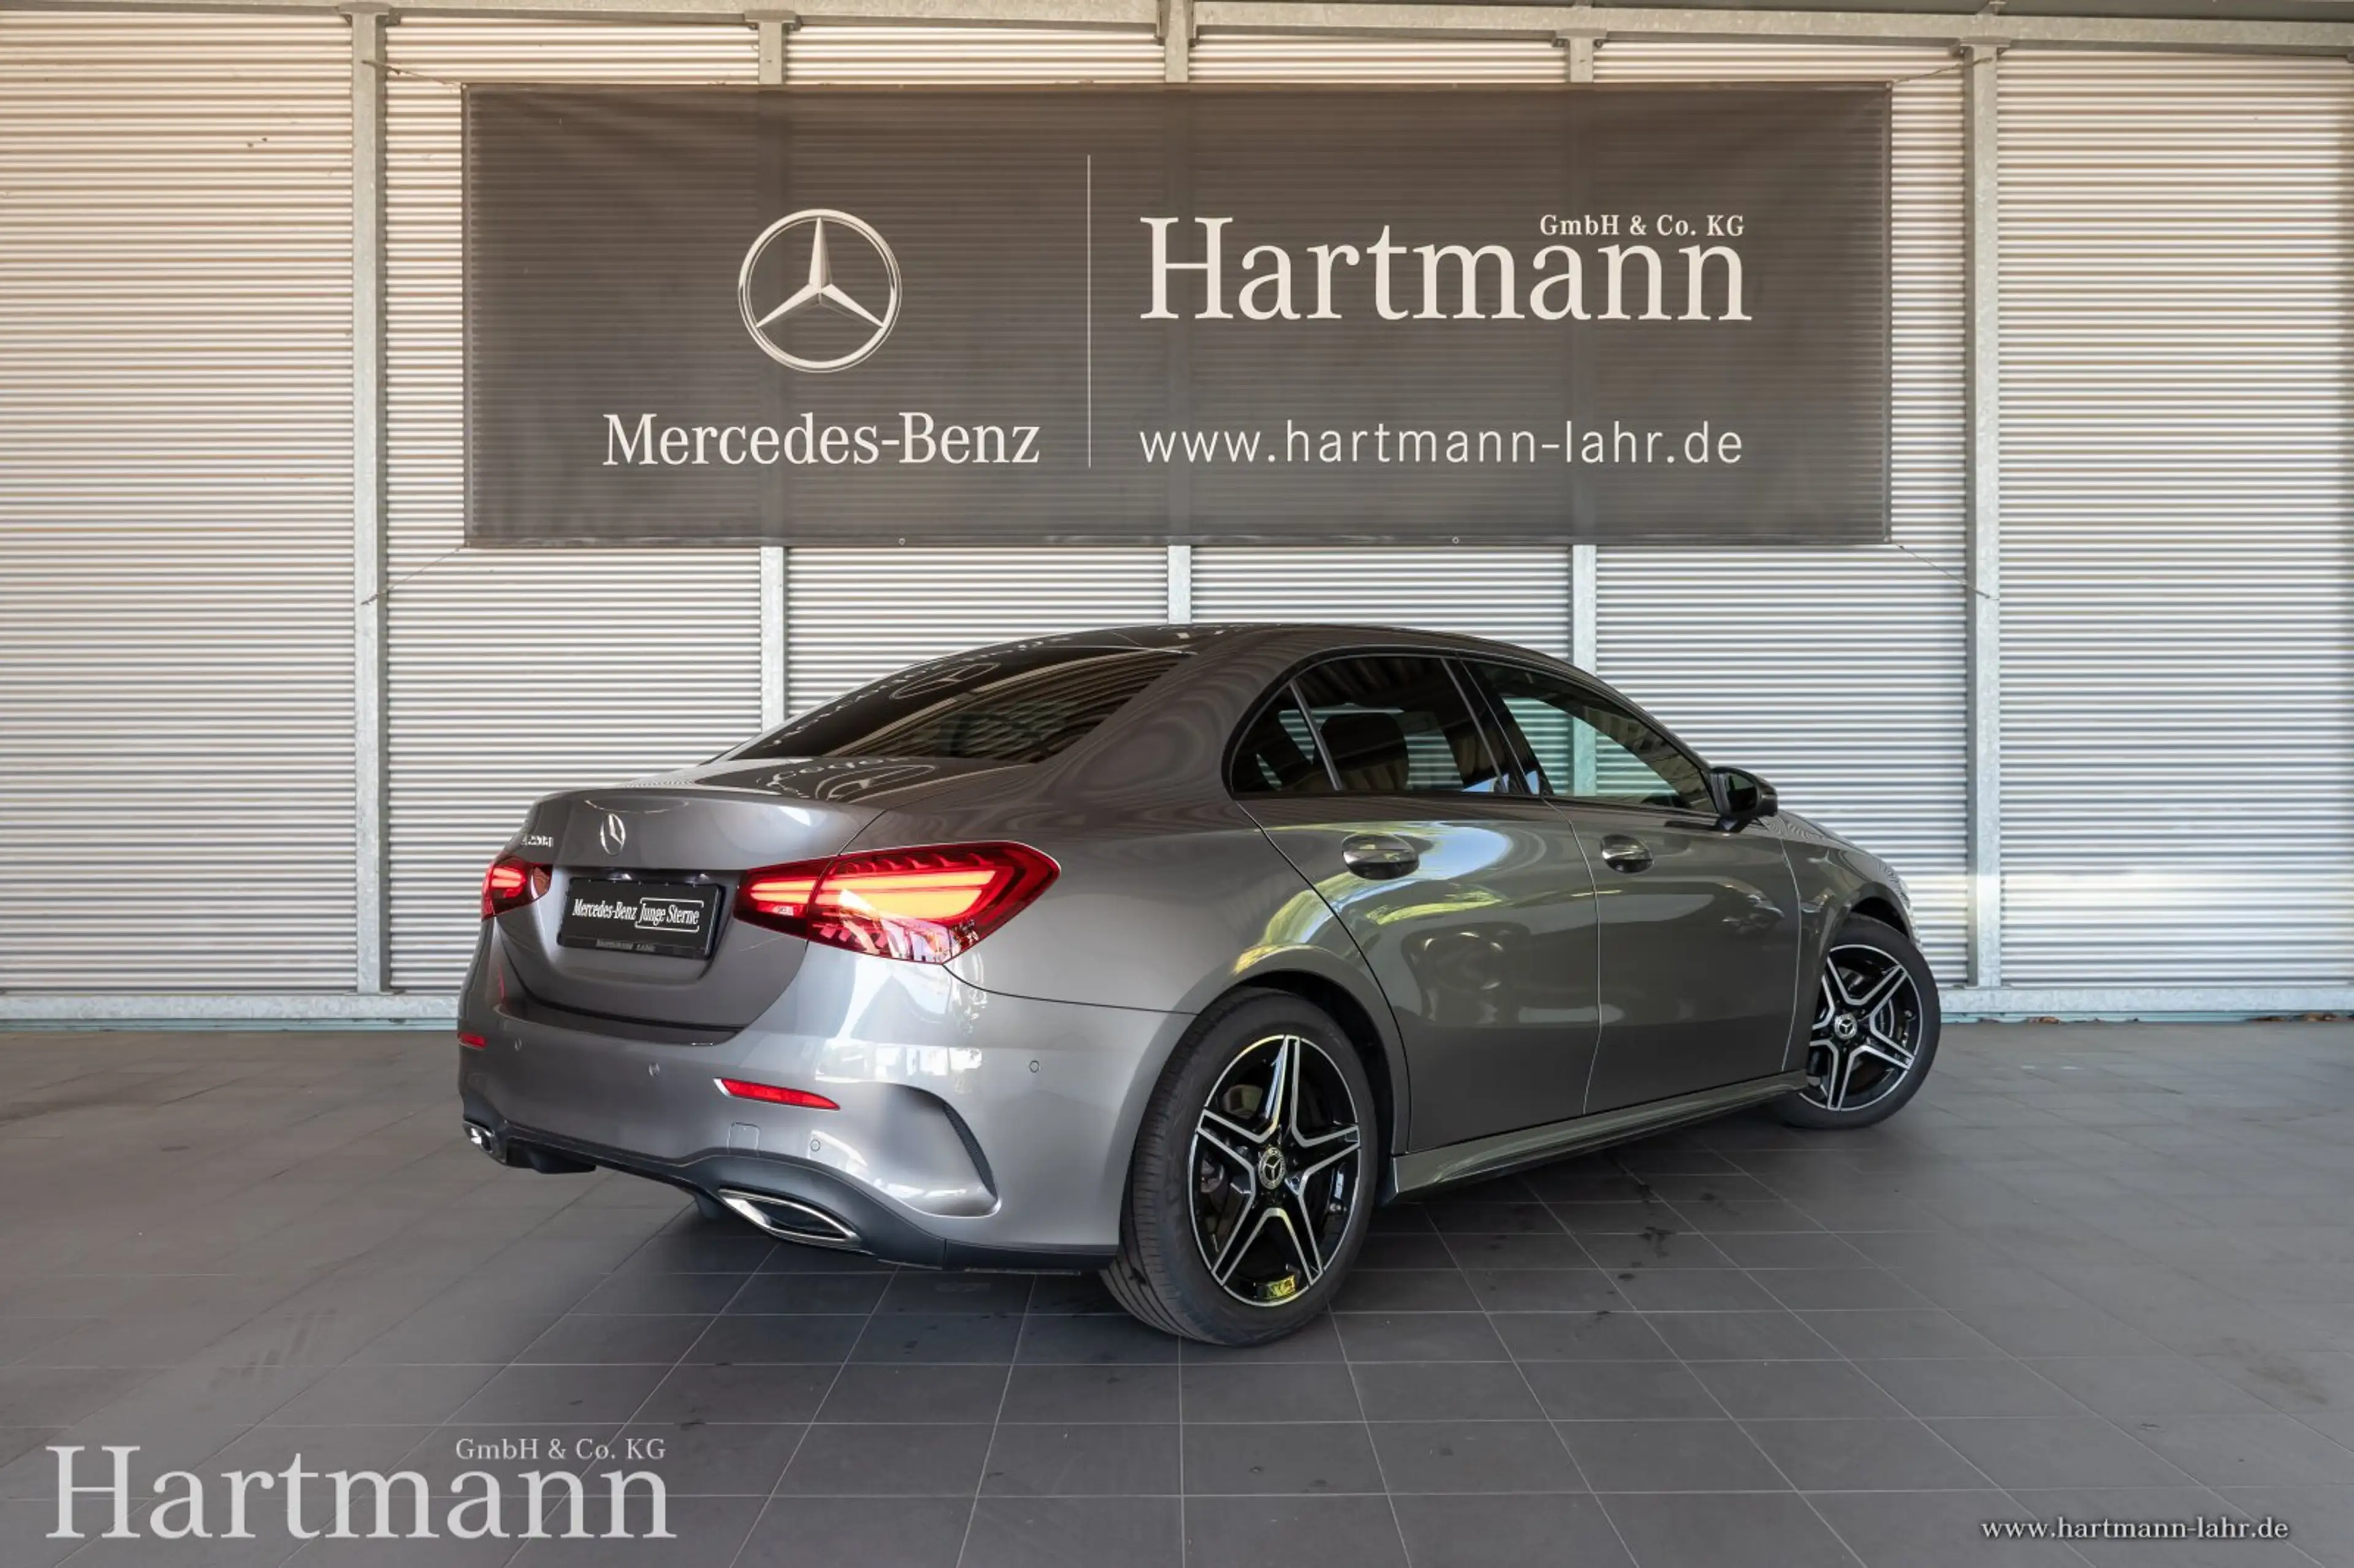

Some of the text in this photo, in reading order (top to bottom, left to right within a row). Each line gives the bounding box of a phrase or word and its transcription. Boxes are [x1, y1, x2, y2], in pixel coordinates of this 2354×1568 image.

[1540, 214, 1744, 237] GmbH & Co. KG
[1139, 216, 1753, 321] Hartmann
[603, 411, 1041, 466] Mercedes-Benz
[1139, 419, 1743, 464] www.hartmann-lahr.de
[572, 898, 700, 926] Mercedes-Benz Junge Sterne
